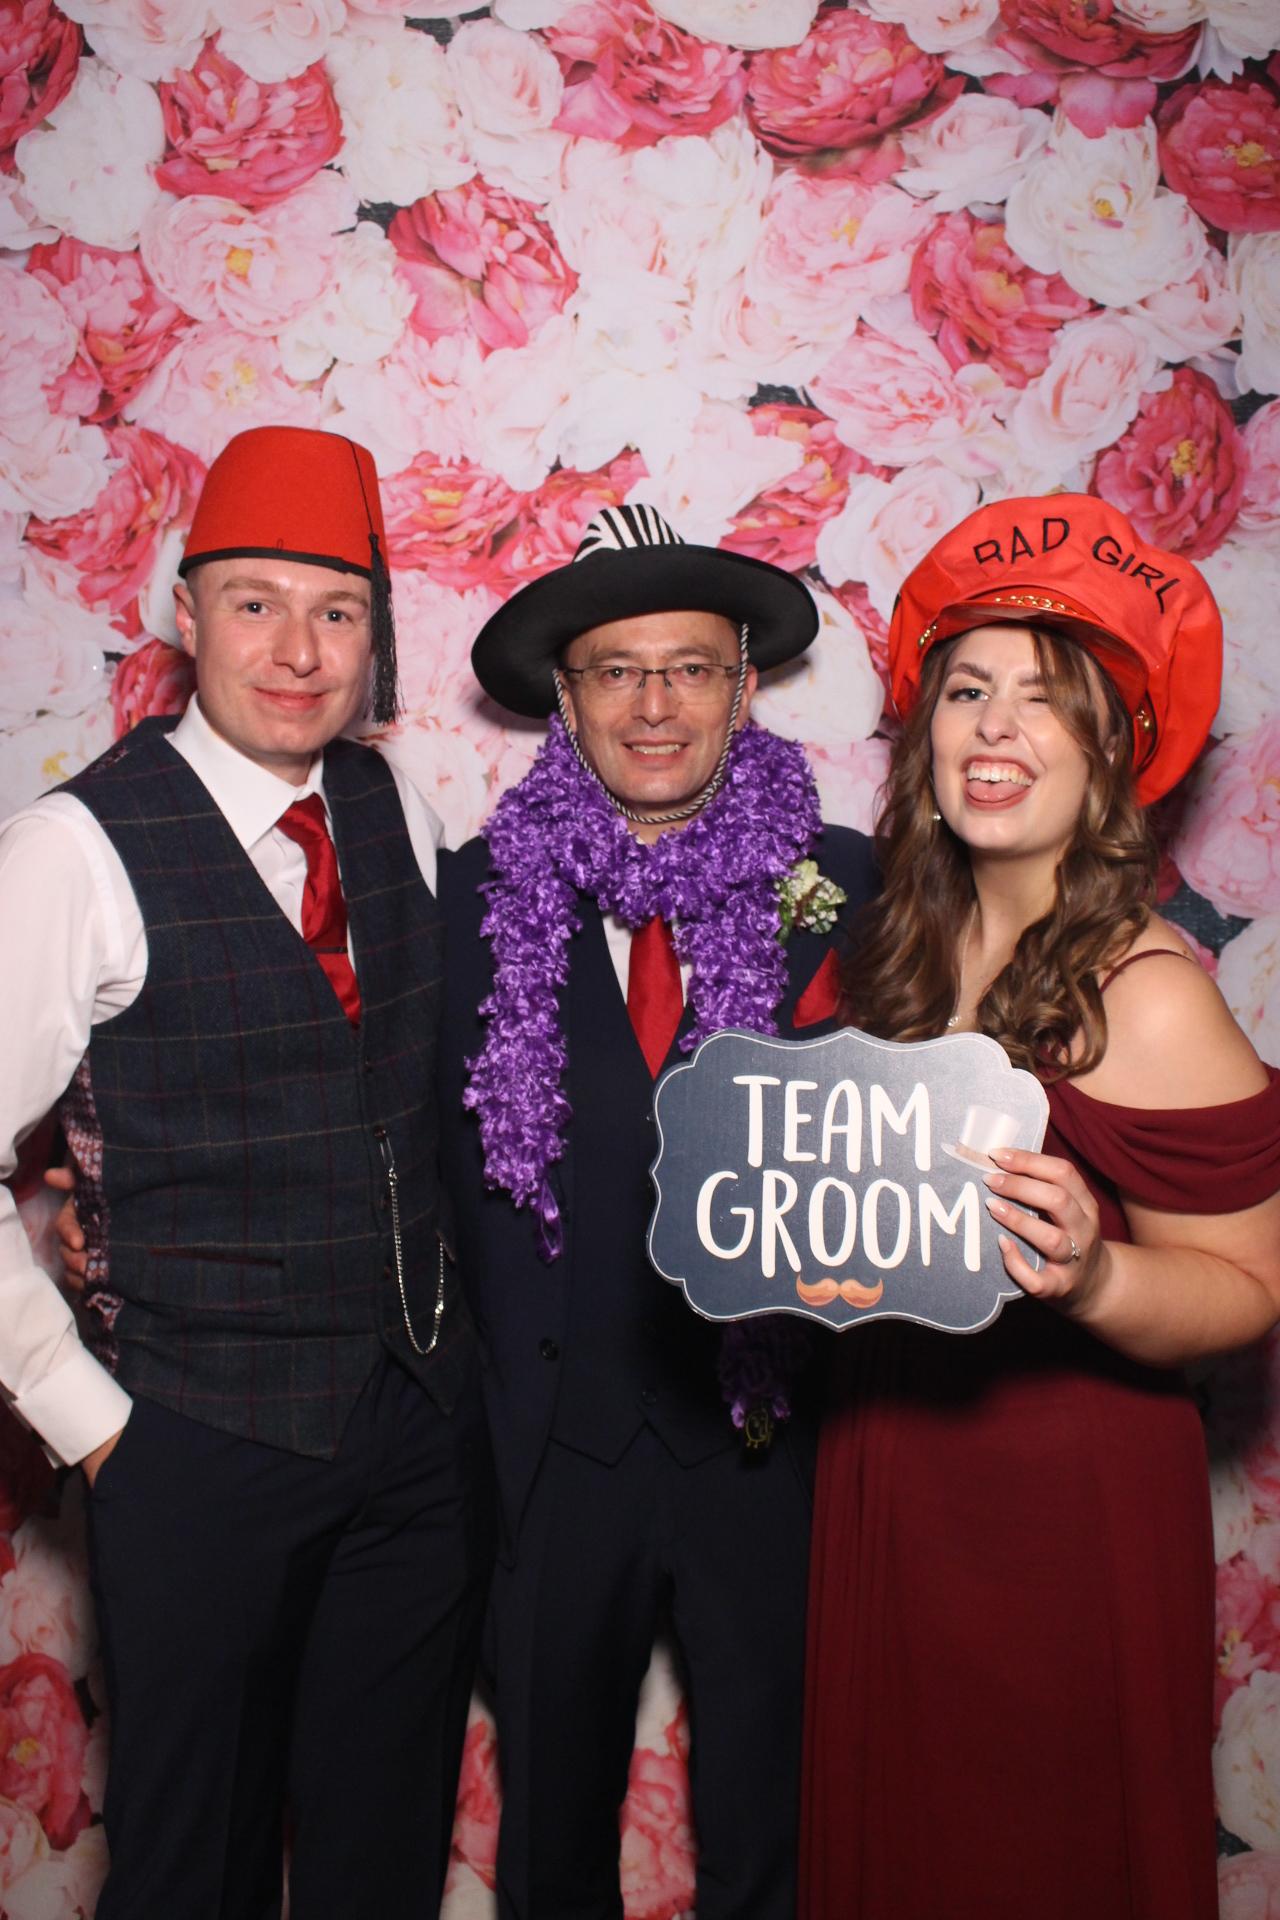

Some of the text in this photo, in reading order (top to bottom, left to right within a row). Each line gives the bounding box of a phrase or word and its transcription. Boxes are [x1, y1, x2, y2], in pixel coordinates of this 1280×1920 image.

[1091, 535, 1181, 614] GIRL
[732, 1075, 931, 1172] TEAM
[696, 1169, 981, 1278] GROOM
